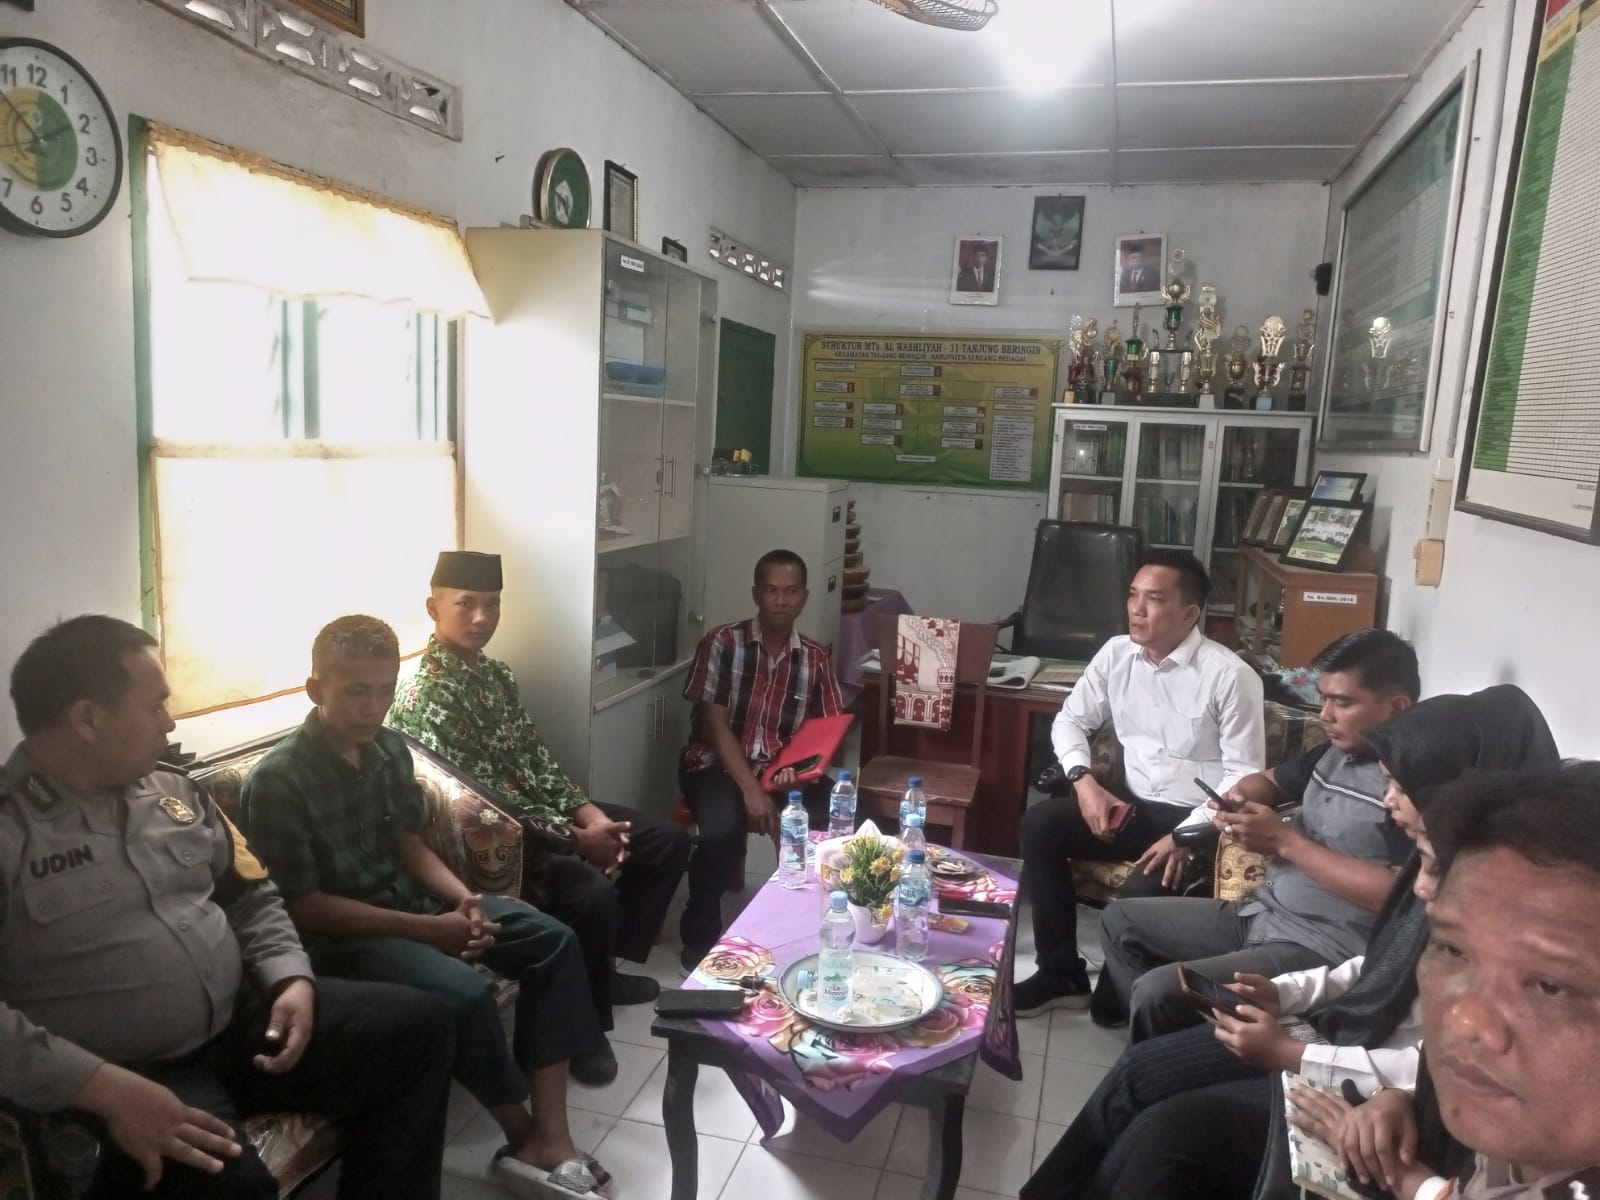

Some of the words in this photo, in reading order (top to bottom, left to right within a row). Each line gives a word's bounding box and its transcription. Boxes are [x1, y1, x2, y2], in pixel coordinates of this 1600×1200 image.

[1, 64, 17, 87] 11
[27, 63, 47, 88] 12
[60, 85, 68, 104] 1
[79, 114, 90, 134] 2
[86, 147, 98, 166] 3
[2, 177, 13, 198] 7
[75, 177, 89, 196] 4
[30, 195, 43, 215] 6
[60, 192, 73, 212] 5
[821, 340, 861, 351] STRUKTUR
[884, 342, 894, 352] AL
[896, 342, 942, 353] WASHLIYAH
[962, 344, 998, 354] TANJUNG
[1001, 345, 1041, 355] BERINGIN
[898, 352, 927, 360] BERINGIN
[931, 353, 966, 361] KABUPATEN
[30, 844, 94, 879] UDIN
